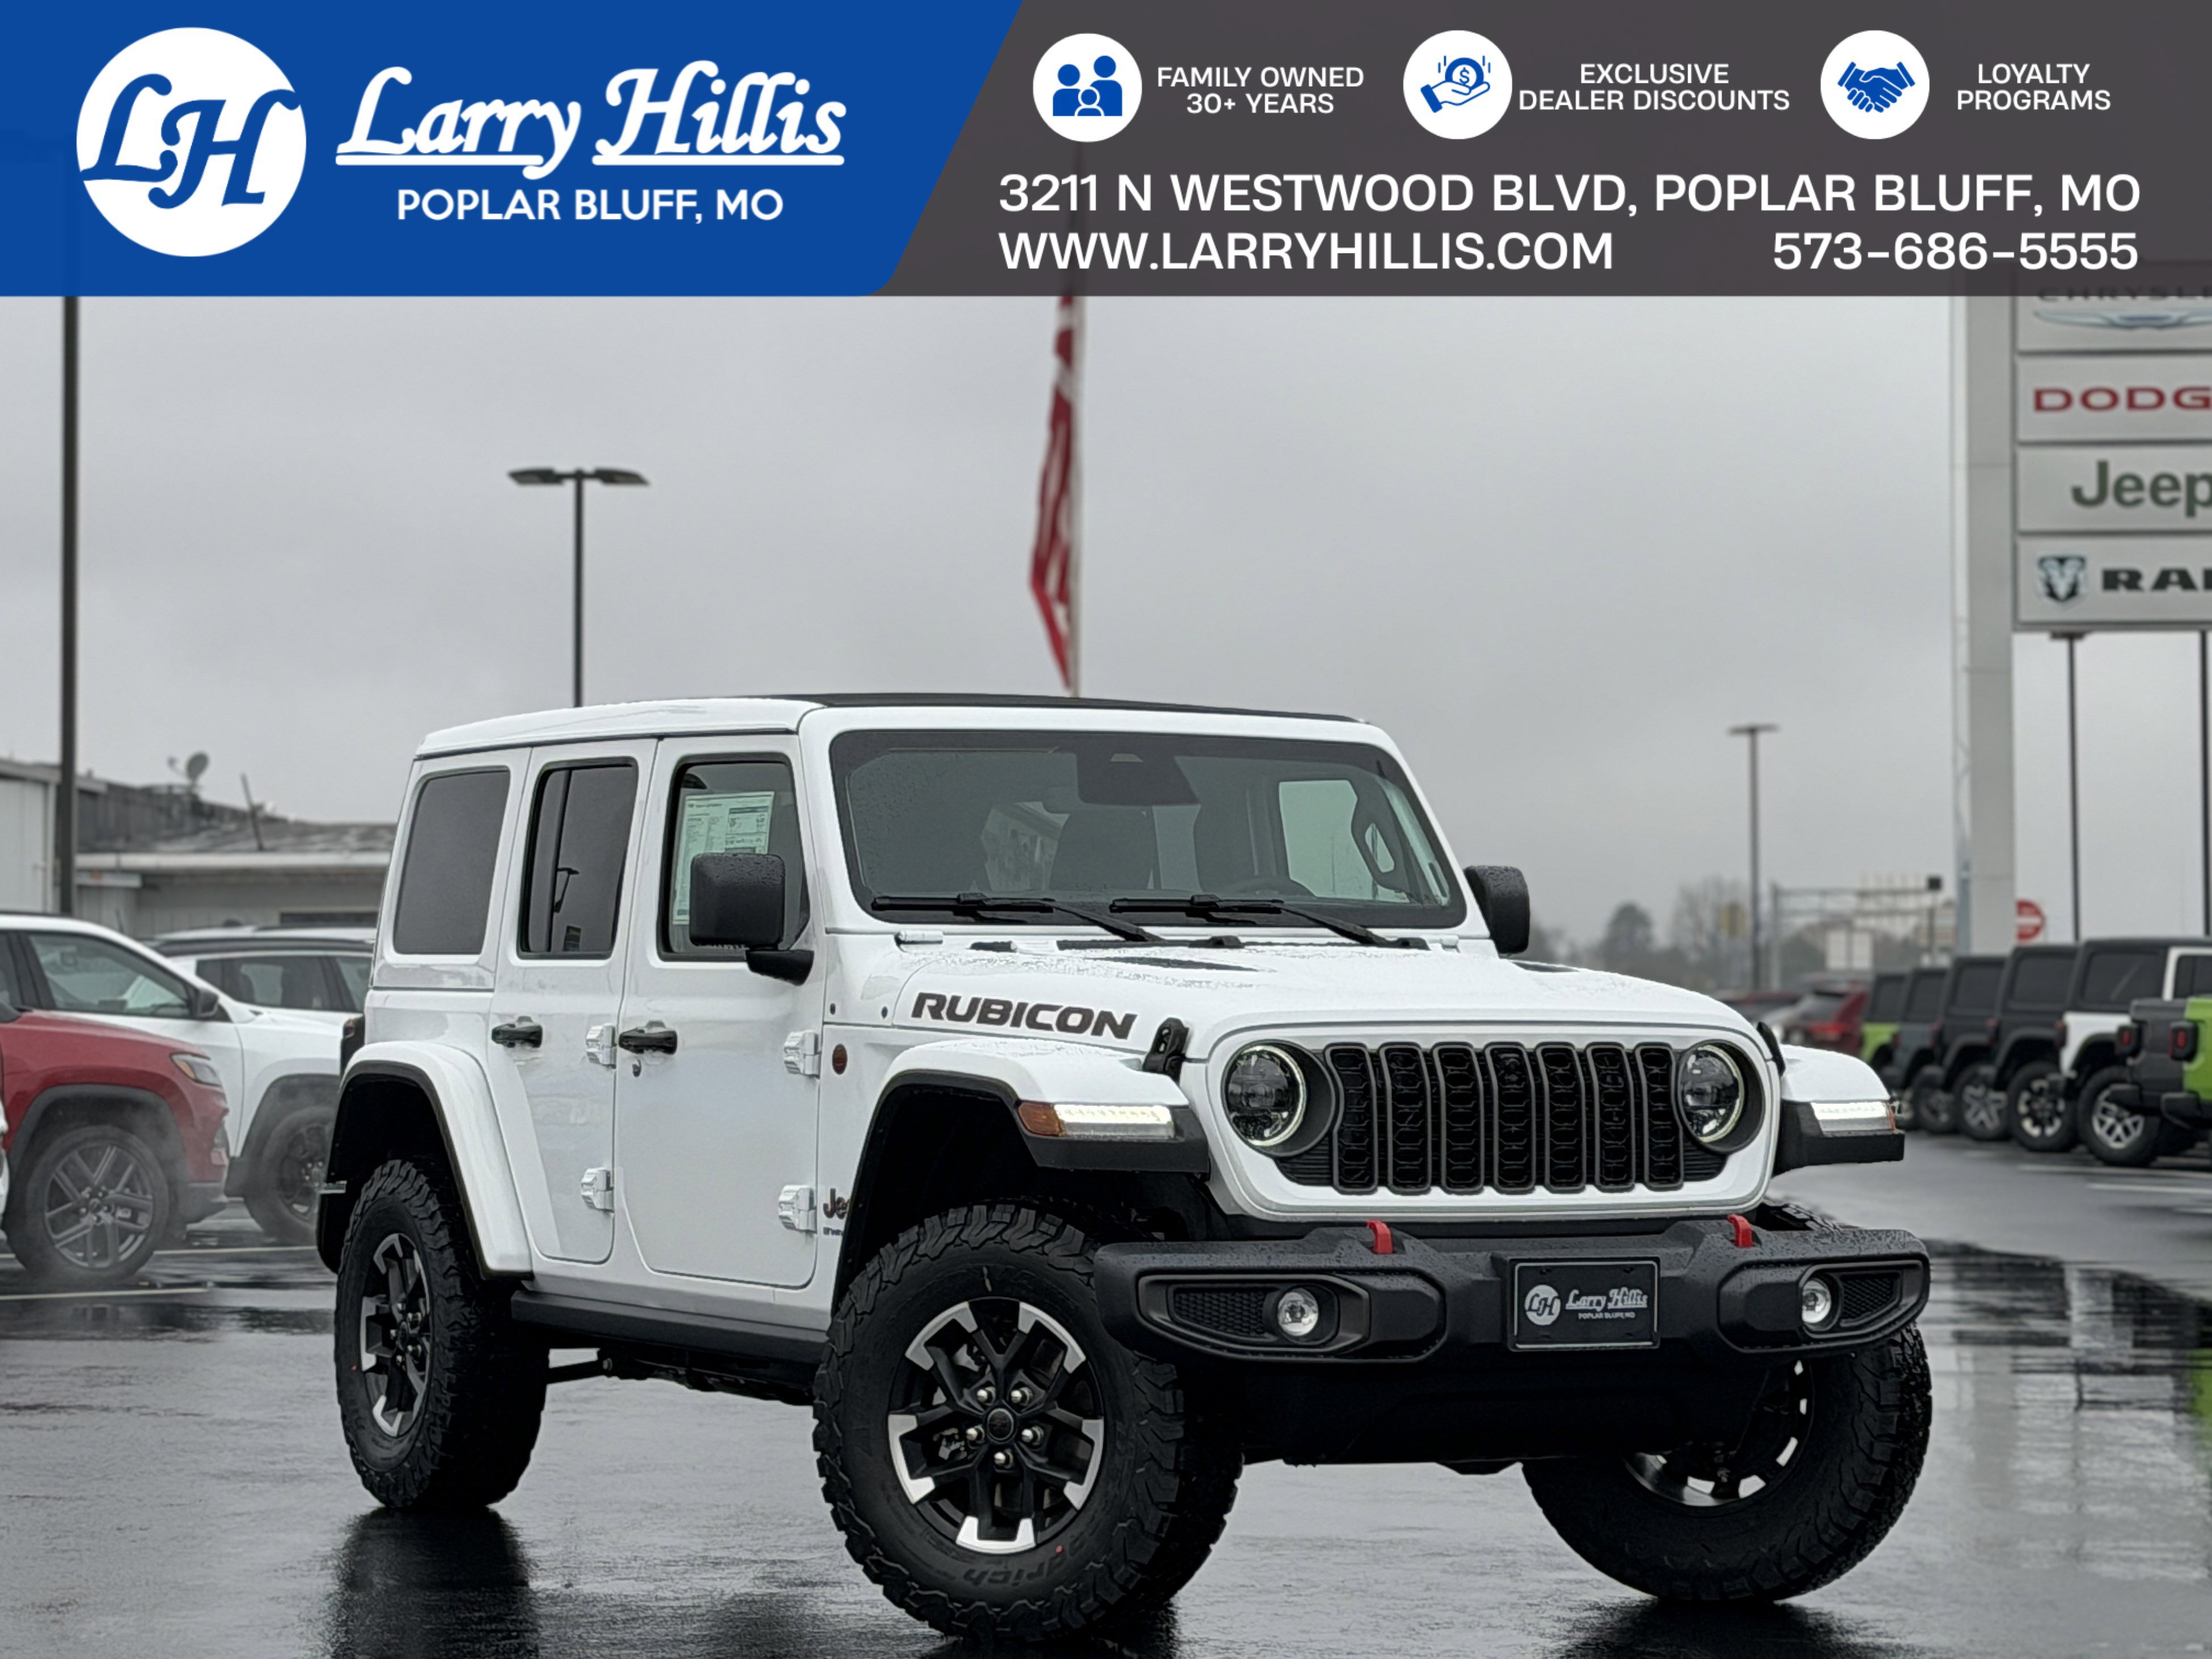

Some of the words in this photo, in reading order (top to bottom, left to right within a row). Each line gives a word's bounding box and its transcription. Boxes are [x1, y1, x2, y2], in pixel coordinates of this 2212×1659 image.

[2071, 460, 2212, 518] Jeep
[2101, 569, 2212, 592] RA
[911, 992, 1137, 1040] RUBICON
[1565, 1289, 1607, 1311] Larry
[1607, 1286, 1648, 1309] Hillis
